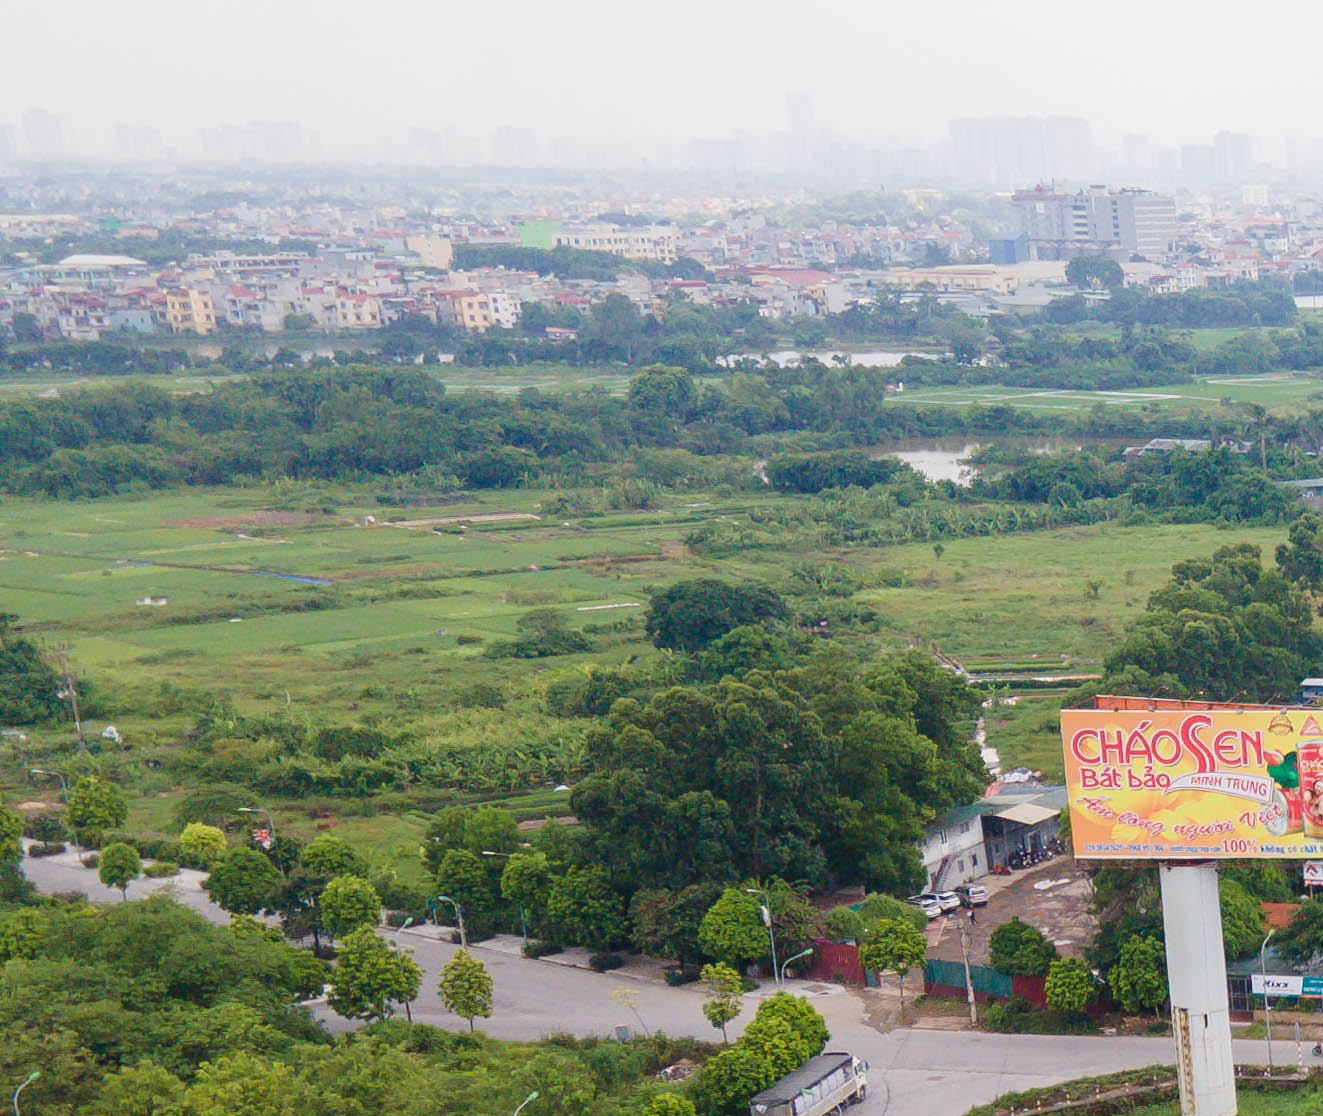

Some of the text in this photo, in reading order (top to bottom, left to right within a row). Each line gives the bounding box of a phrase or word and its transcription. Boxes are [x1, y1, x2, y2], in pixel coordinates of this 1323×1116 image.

[1072, 720, 1182, 768] CHÁO
[1080, 765, 1171, 789] Bát bảo
[1190, 775, 1268, 797] MINH TRUNG
[1223, 839, 1258, 853] 100%
